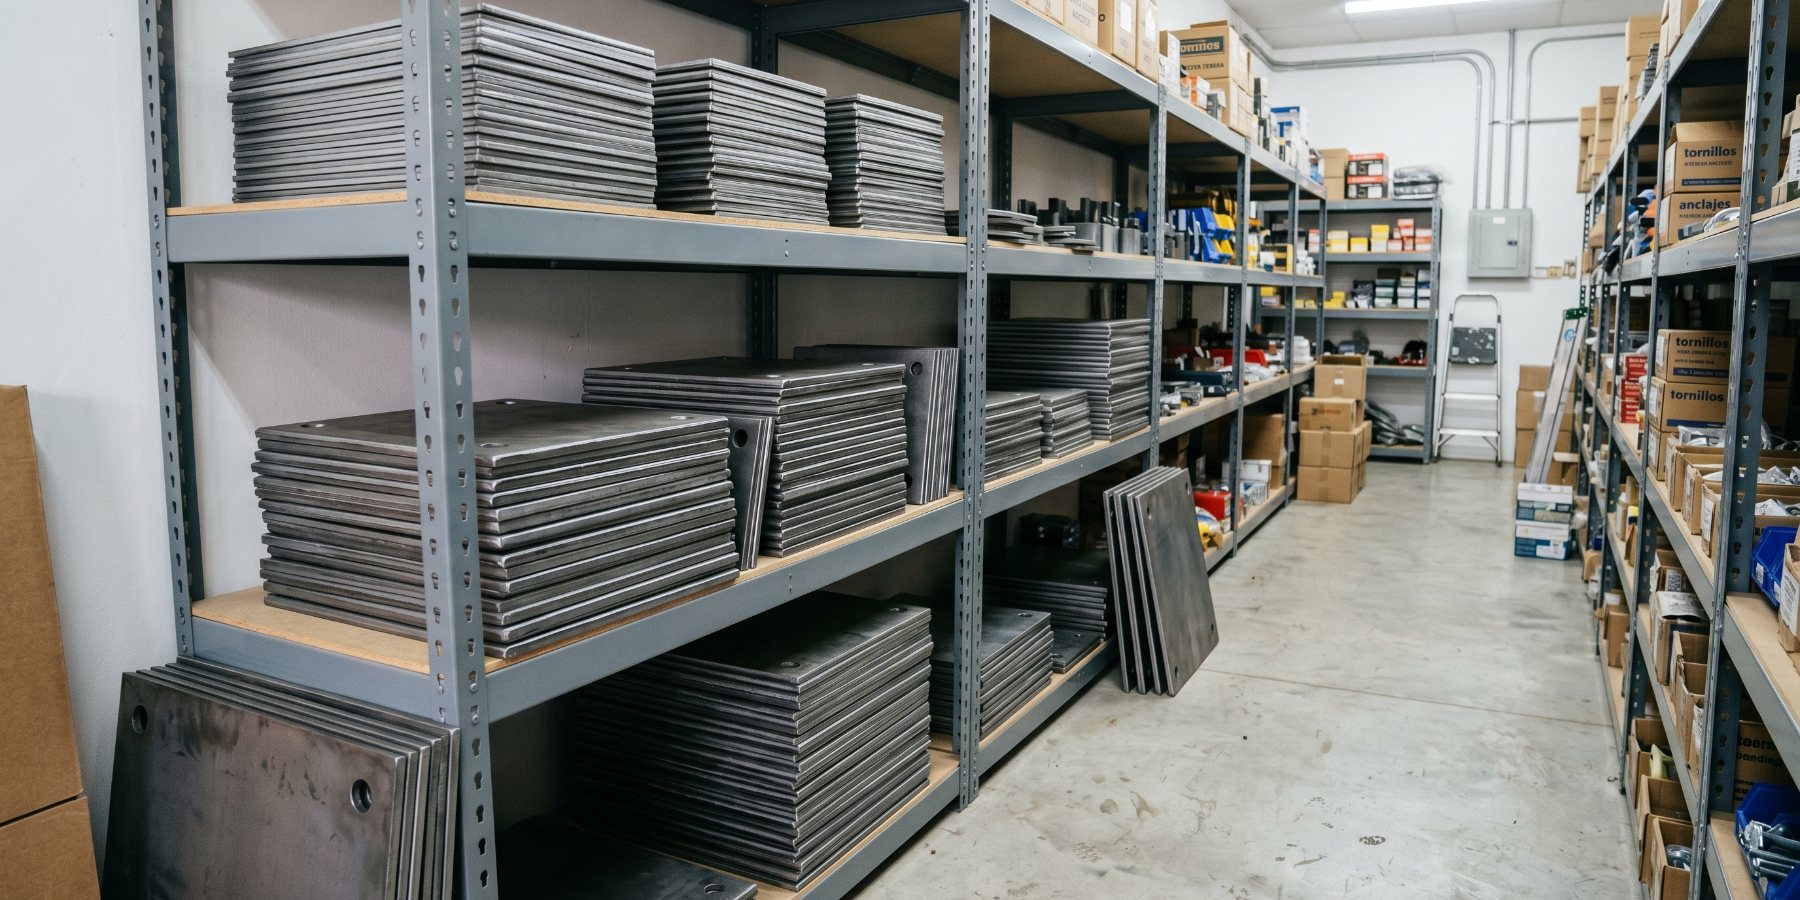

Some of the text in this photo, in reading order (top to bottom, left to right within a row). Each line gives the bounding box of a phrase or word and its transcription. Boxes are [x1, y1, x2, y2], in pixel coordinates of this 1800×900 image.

[1684, 146, 1737, 158] tornillos
[1679, 199, 1731, 211] anclajes
[1676, 337, 1728, 348] tornillos
[1671, 390, 1724, 402] tornillos
